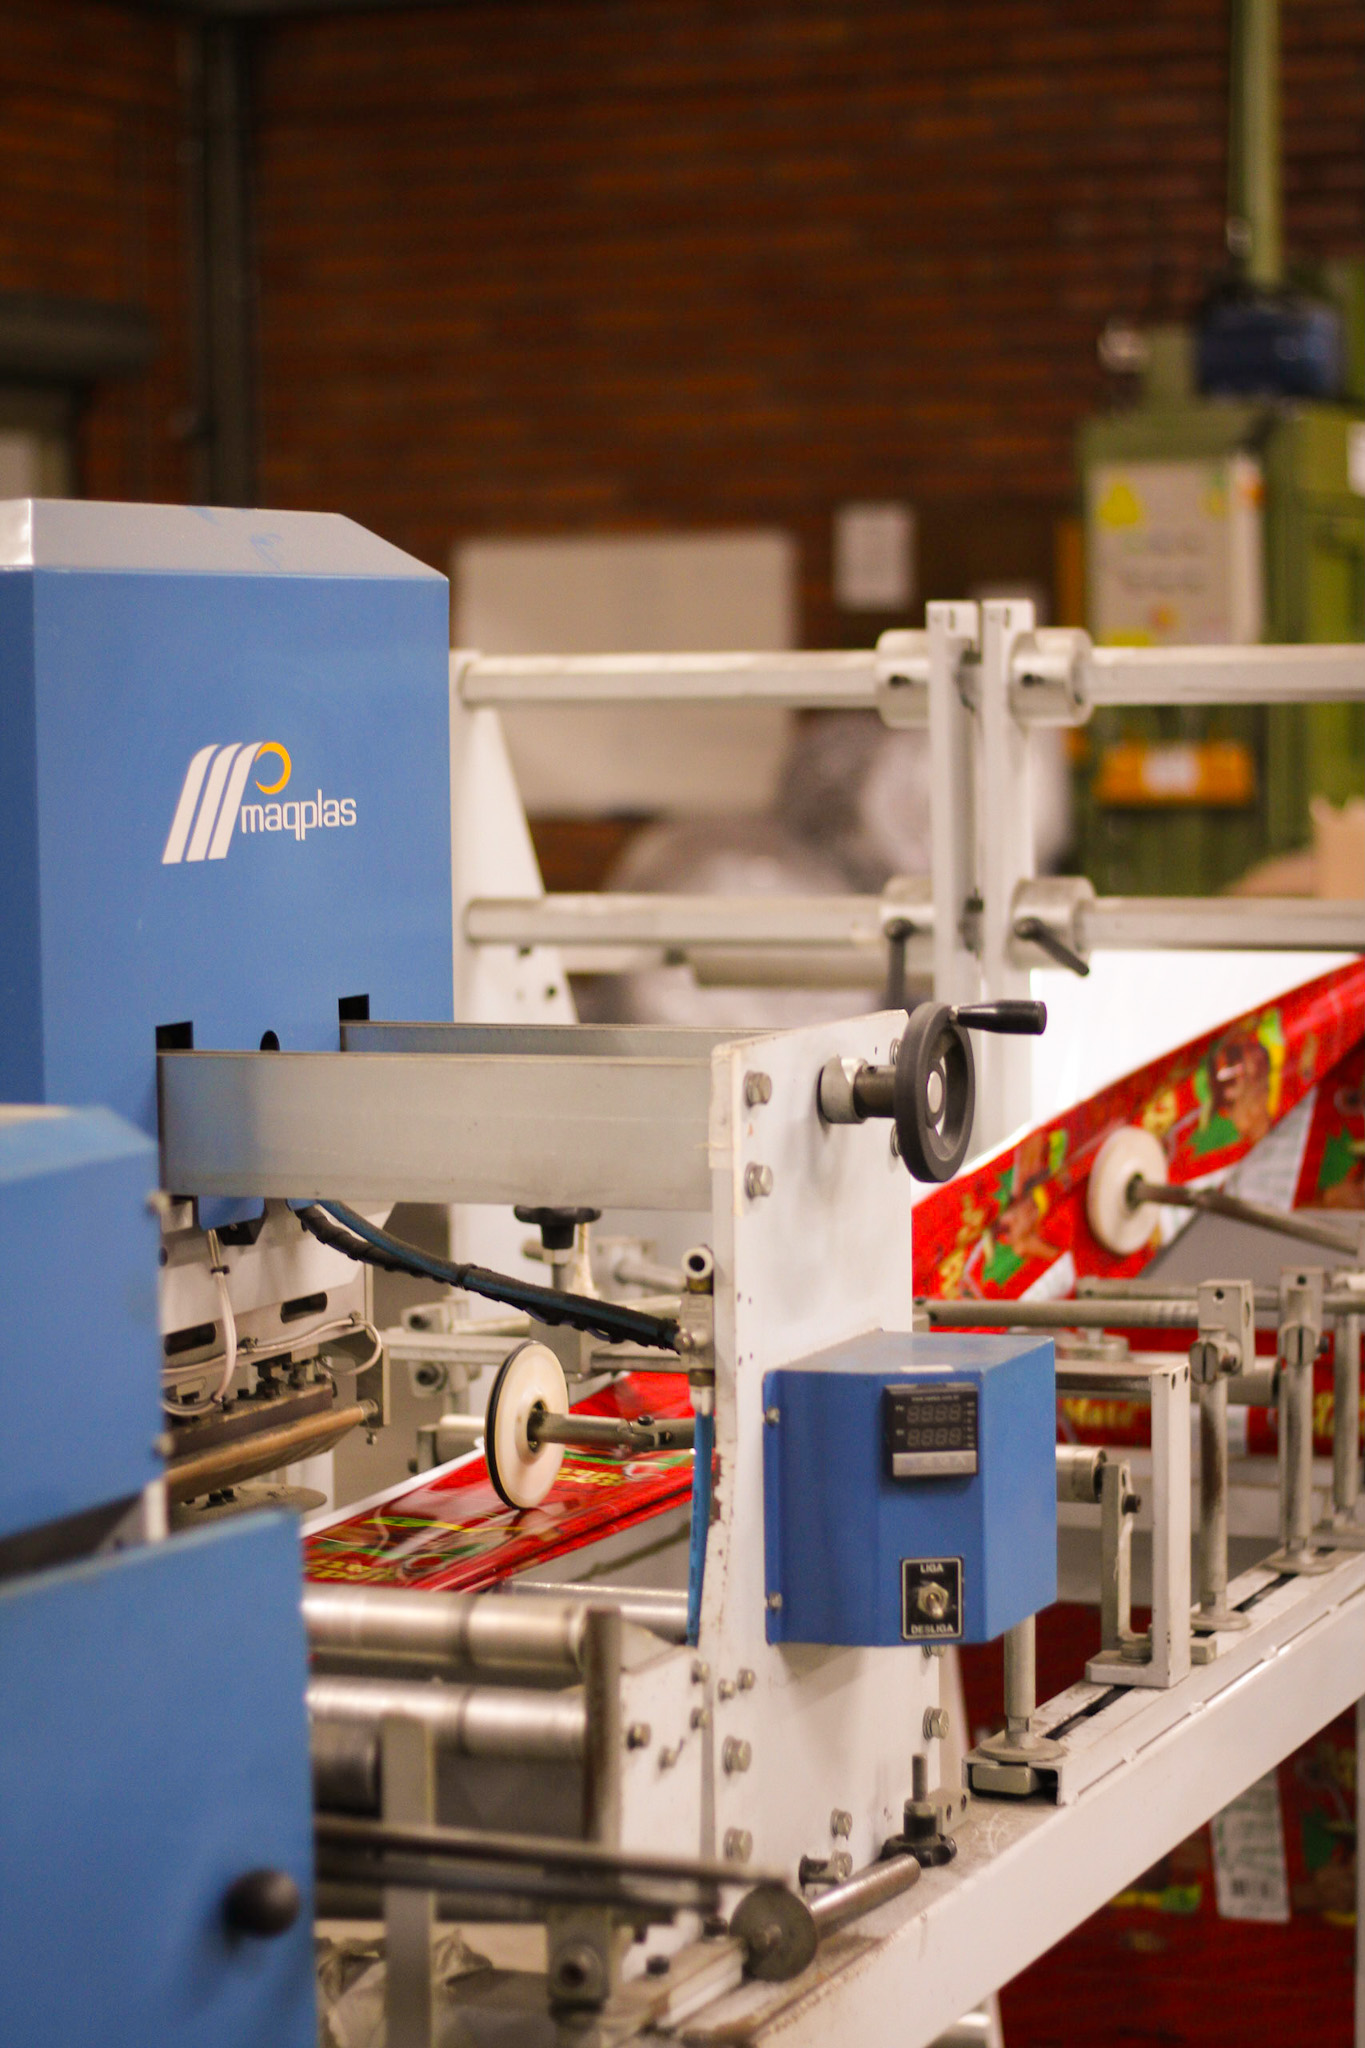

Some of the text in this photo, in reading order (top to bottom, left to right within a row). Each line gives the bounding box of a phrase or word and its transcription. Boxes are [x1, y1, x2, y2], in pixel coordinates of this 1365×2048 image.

[241, 788, 357, 841] maqplas
[919, 1563, 944, 1574] LIGA
[910, 1623, 954, 1634] DESLIGA
